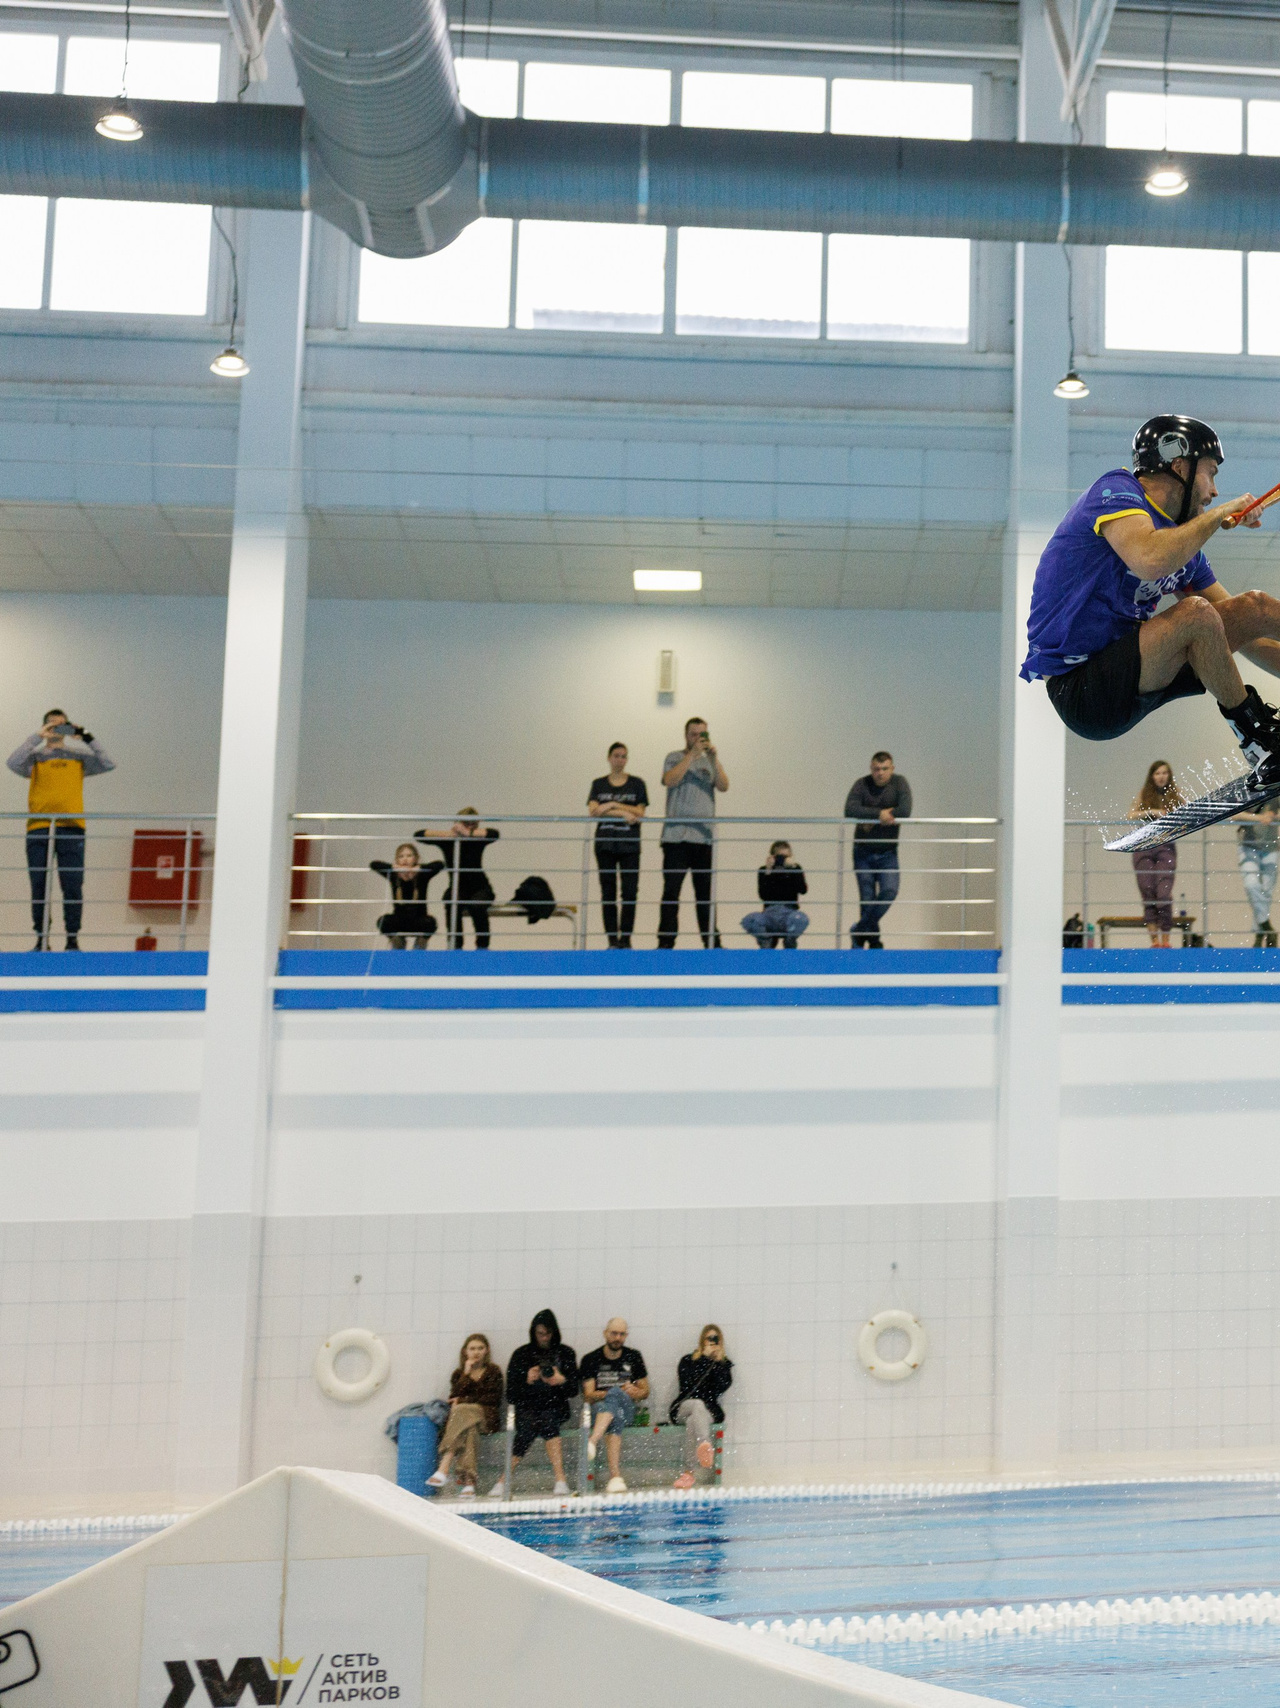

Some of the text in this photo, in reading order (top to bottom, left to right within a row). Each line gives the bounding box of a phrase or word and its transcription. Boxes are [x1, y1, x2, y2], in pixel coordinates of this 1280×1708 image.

[330, 1653, 379, 1668] СЕТЬ
[321, 1669, 388, 1686] АКТИВ
[318, 1685, 401, 1704] ПАРКОВ
